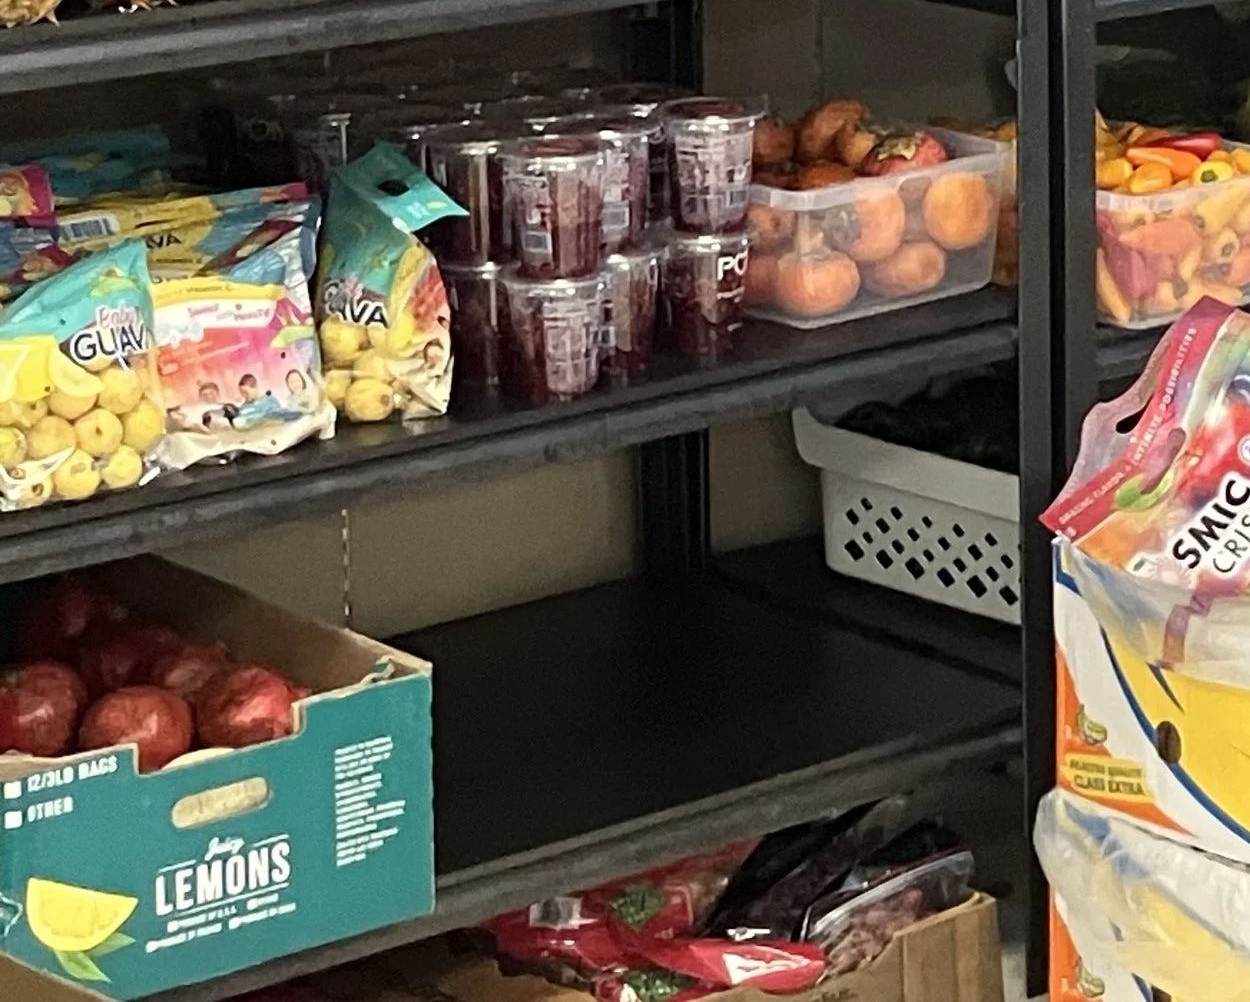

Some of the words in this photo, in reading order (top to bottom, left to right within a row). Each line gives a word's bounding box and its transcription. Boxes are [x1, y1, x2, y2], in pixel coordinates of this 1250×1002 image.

[74, 324, 153, 361] GUAV
[78, 755, 118, 780] BAGS
[1108, 780, 1146, 795] EXTRA
[27, 796, 74, 823] OTHER
[155, 841, 291, 916] LEMONS
